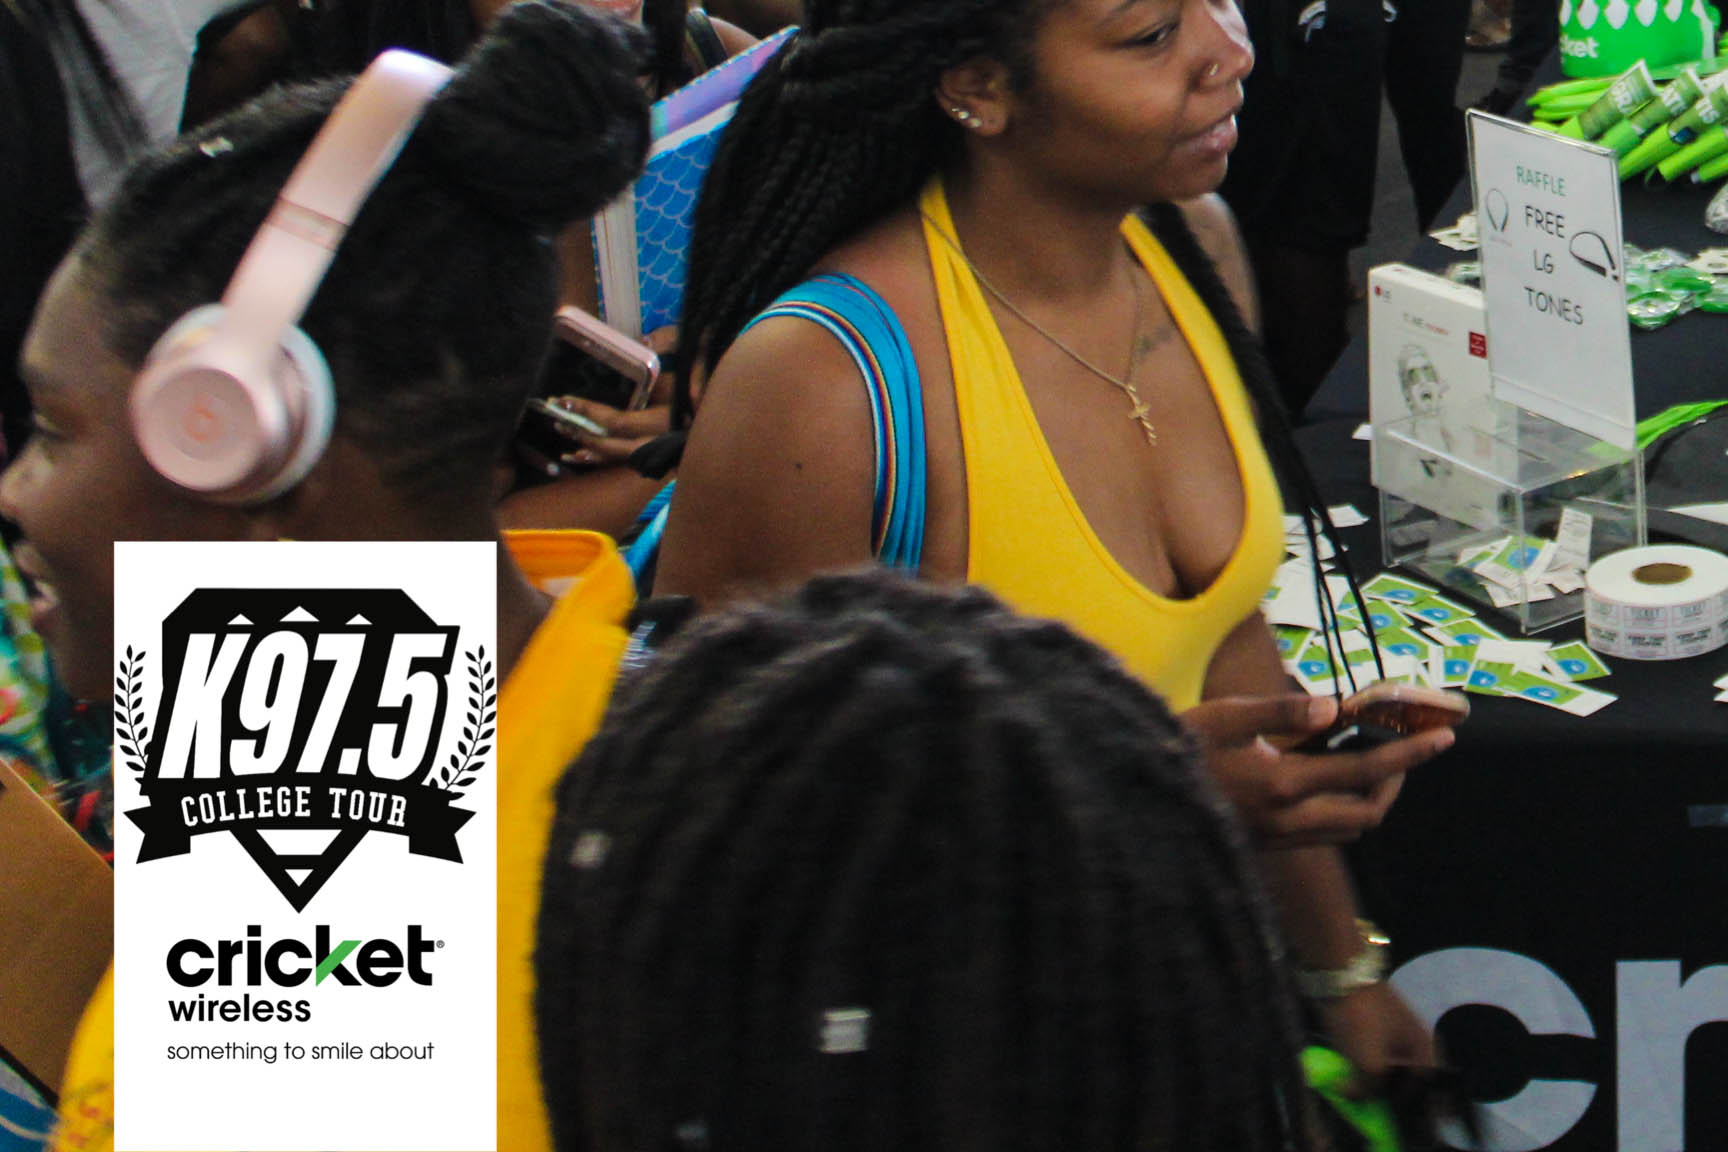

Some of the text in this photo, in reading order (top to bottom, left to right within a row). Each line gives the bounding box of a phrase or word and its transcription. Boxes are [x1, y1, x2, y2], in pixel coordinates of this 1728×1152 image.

[1516, 165, 1566, 197] RAFFLE
[1525, 205, 1565, 239] FREE
[1533, 249, 1554, 274] LG
[1524, 286, 1584, 326] TONES
